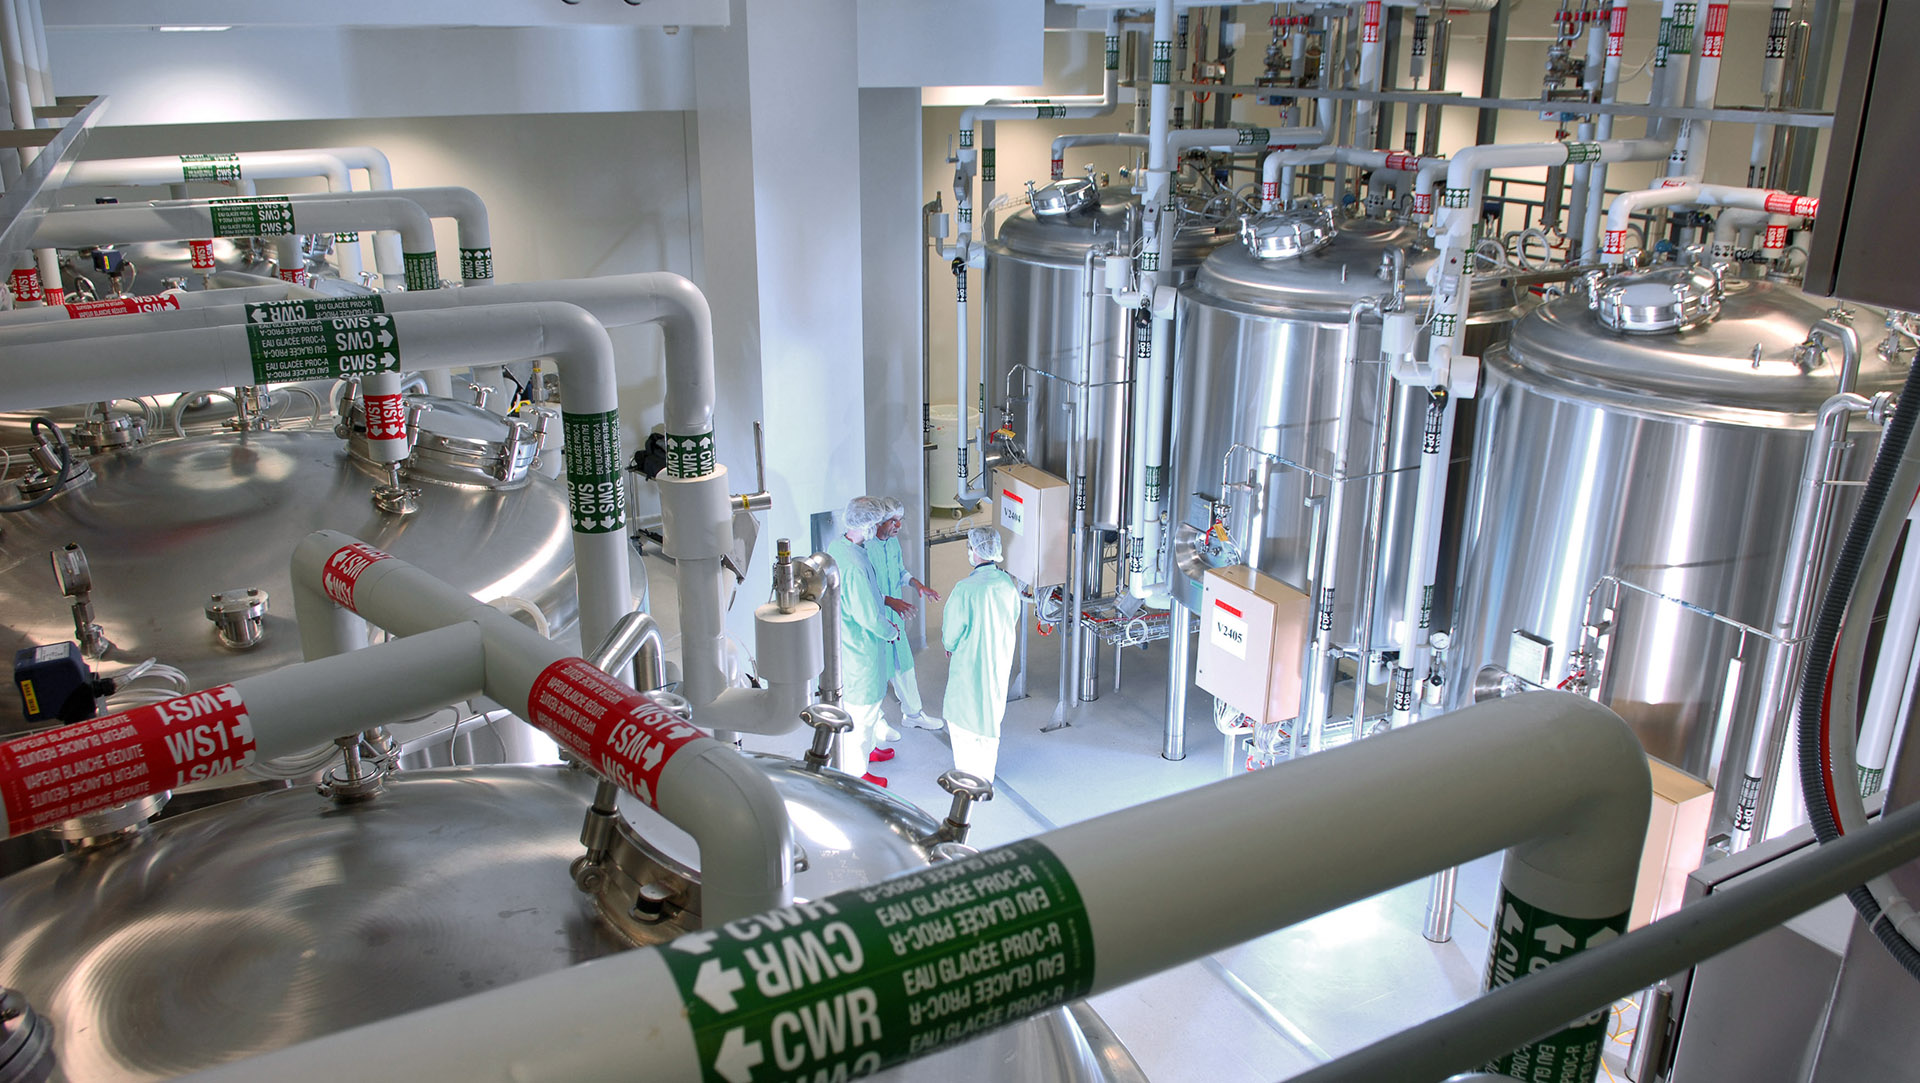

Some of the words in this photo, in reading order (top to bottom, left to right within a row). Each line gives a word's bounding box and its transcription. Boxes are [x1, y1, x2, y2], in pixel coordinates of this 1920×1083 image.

[258, 210, 280, 221] CWS
[260, 222, 282, 232] CWS
[206, 243, 214, 259] WS1
[464, 260, 474, 279] CWR
[474, 259, 485, 279] CWR
[18, 275, 30, 292] WS1
[30, 273, 39, 290] WS1
[131, 295, 160, 304] WS1
[138, 303, 163, 313] WS1
[332, 316, 371, 330] CWS
[262, 339, 275, 348] EAU
[276, 335, 300, 347] GLACÉE
[301, 334, 326, 345] PROC-A
[315, 345, 328, 354] EAU
[336, 331, 374, 352] CWS
[263, 349, 289, 359] PROC-A
[265, 362, 279, 371] EAU
[280, 359, 304, 370] GLACÉE
[304, 358, 329, 367] PROC-A
[339, 353, 377, 372] CWS
[368, 401, 382, 425] WS1
[382, 398, 399, 423] WS1
[581, 424, 590, 435] EAU
[584, 455, 593, 476] PROC-A
[596, 465, 604, 475] EAU
[682, 452, 698, 479] CWR
[578, 483, 596, 514] CWS
[597, 482, 615, 514] CWS
[616, 476, 626, 509] CWS
[1004, 506, 1021, 523] V2404
[338, 552, 371, 581] WS1
[333, 575, 354, 609] WS1
[1217, 621, 1243, 644] V2405
[155, 691, 223, 726] WS1
[546, 676, 569, 695] VAPEUR
[562, 686, 589, 708] BLANCHE
[582, 698, 609, 720] RÉDUITE
[556, 701, 580, 725] BLANCHE
[629, 703, 683, 732] WS1
[100, 724, 139, 744] VAPEUR
[576, 714, 597, 737] VAPEUR
[9, 736, 49, 753] VAPEUR
[48, 724, 92, 742] BLANCHE
[56, 734, 101, 757] BLANCHE
[164, 720, 230, 765] WS1
[606, 718, 653, 765] WS1
[16, 745, 58, 768] RÉDUITE
[23, 767, 63, 790] VAPEUR
[61, 754, 106, 780] BLANCHE
[105, 743, 145, 766] RÉDUITE
[69, 772, 113, 796] BLANCHE
[113, 762, 150, 783] VAPEUR
[176, 756, 233, 788] WS1
[601, 752, 637, 796] WS1
[29, 785, 70, 809] RÉDUITE
[113, 780, 150, 800] RÉDUITE
[875, 903, 913, 928] EAU
[911, 881, 977, 917] GLACÉE
[973, 863, 1038, 898] PROC-R
[1015, 885, 1052, 916] EAU
[723, 898, 841, 942] CWR
[953, 897, 1017, 937] GLACÉE
[888, 916, 956, 957] PROC-R
[743, 920, 865, 1000] CWR
[902, 961, 937, 997] EAU
[938, 939, 1001, 984] GLACÉE
[1000, 921, 1063, 963] PROC-R
[1035, 952, 1066, 979] EAU
[974, 964, 1033, 1005] GLACÉE
[908, 985, 971, 1026] PROC-R
[771, 986, 883, 1072] CWR
[909, 1028, 942, 1052] EAU
[943, 1006, 1002, 1041] GLACÉE
[1006, 985, 1065, 1018] PROC-R
[1534, 1044, 1557, 1067] EAU
